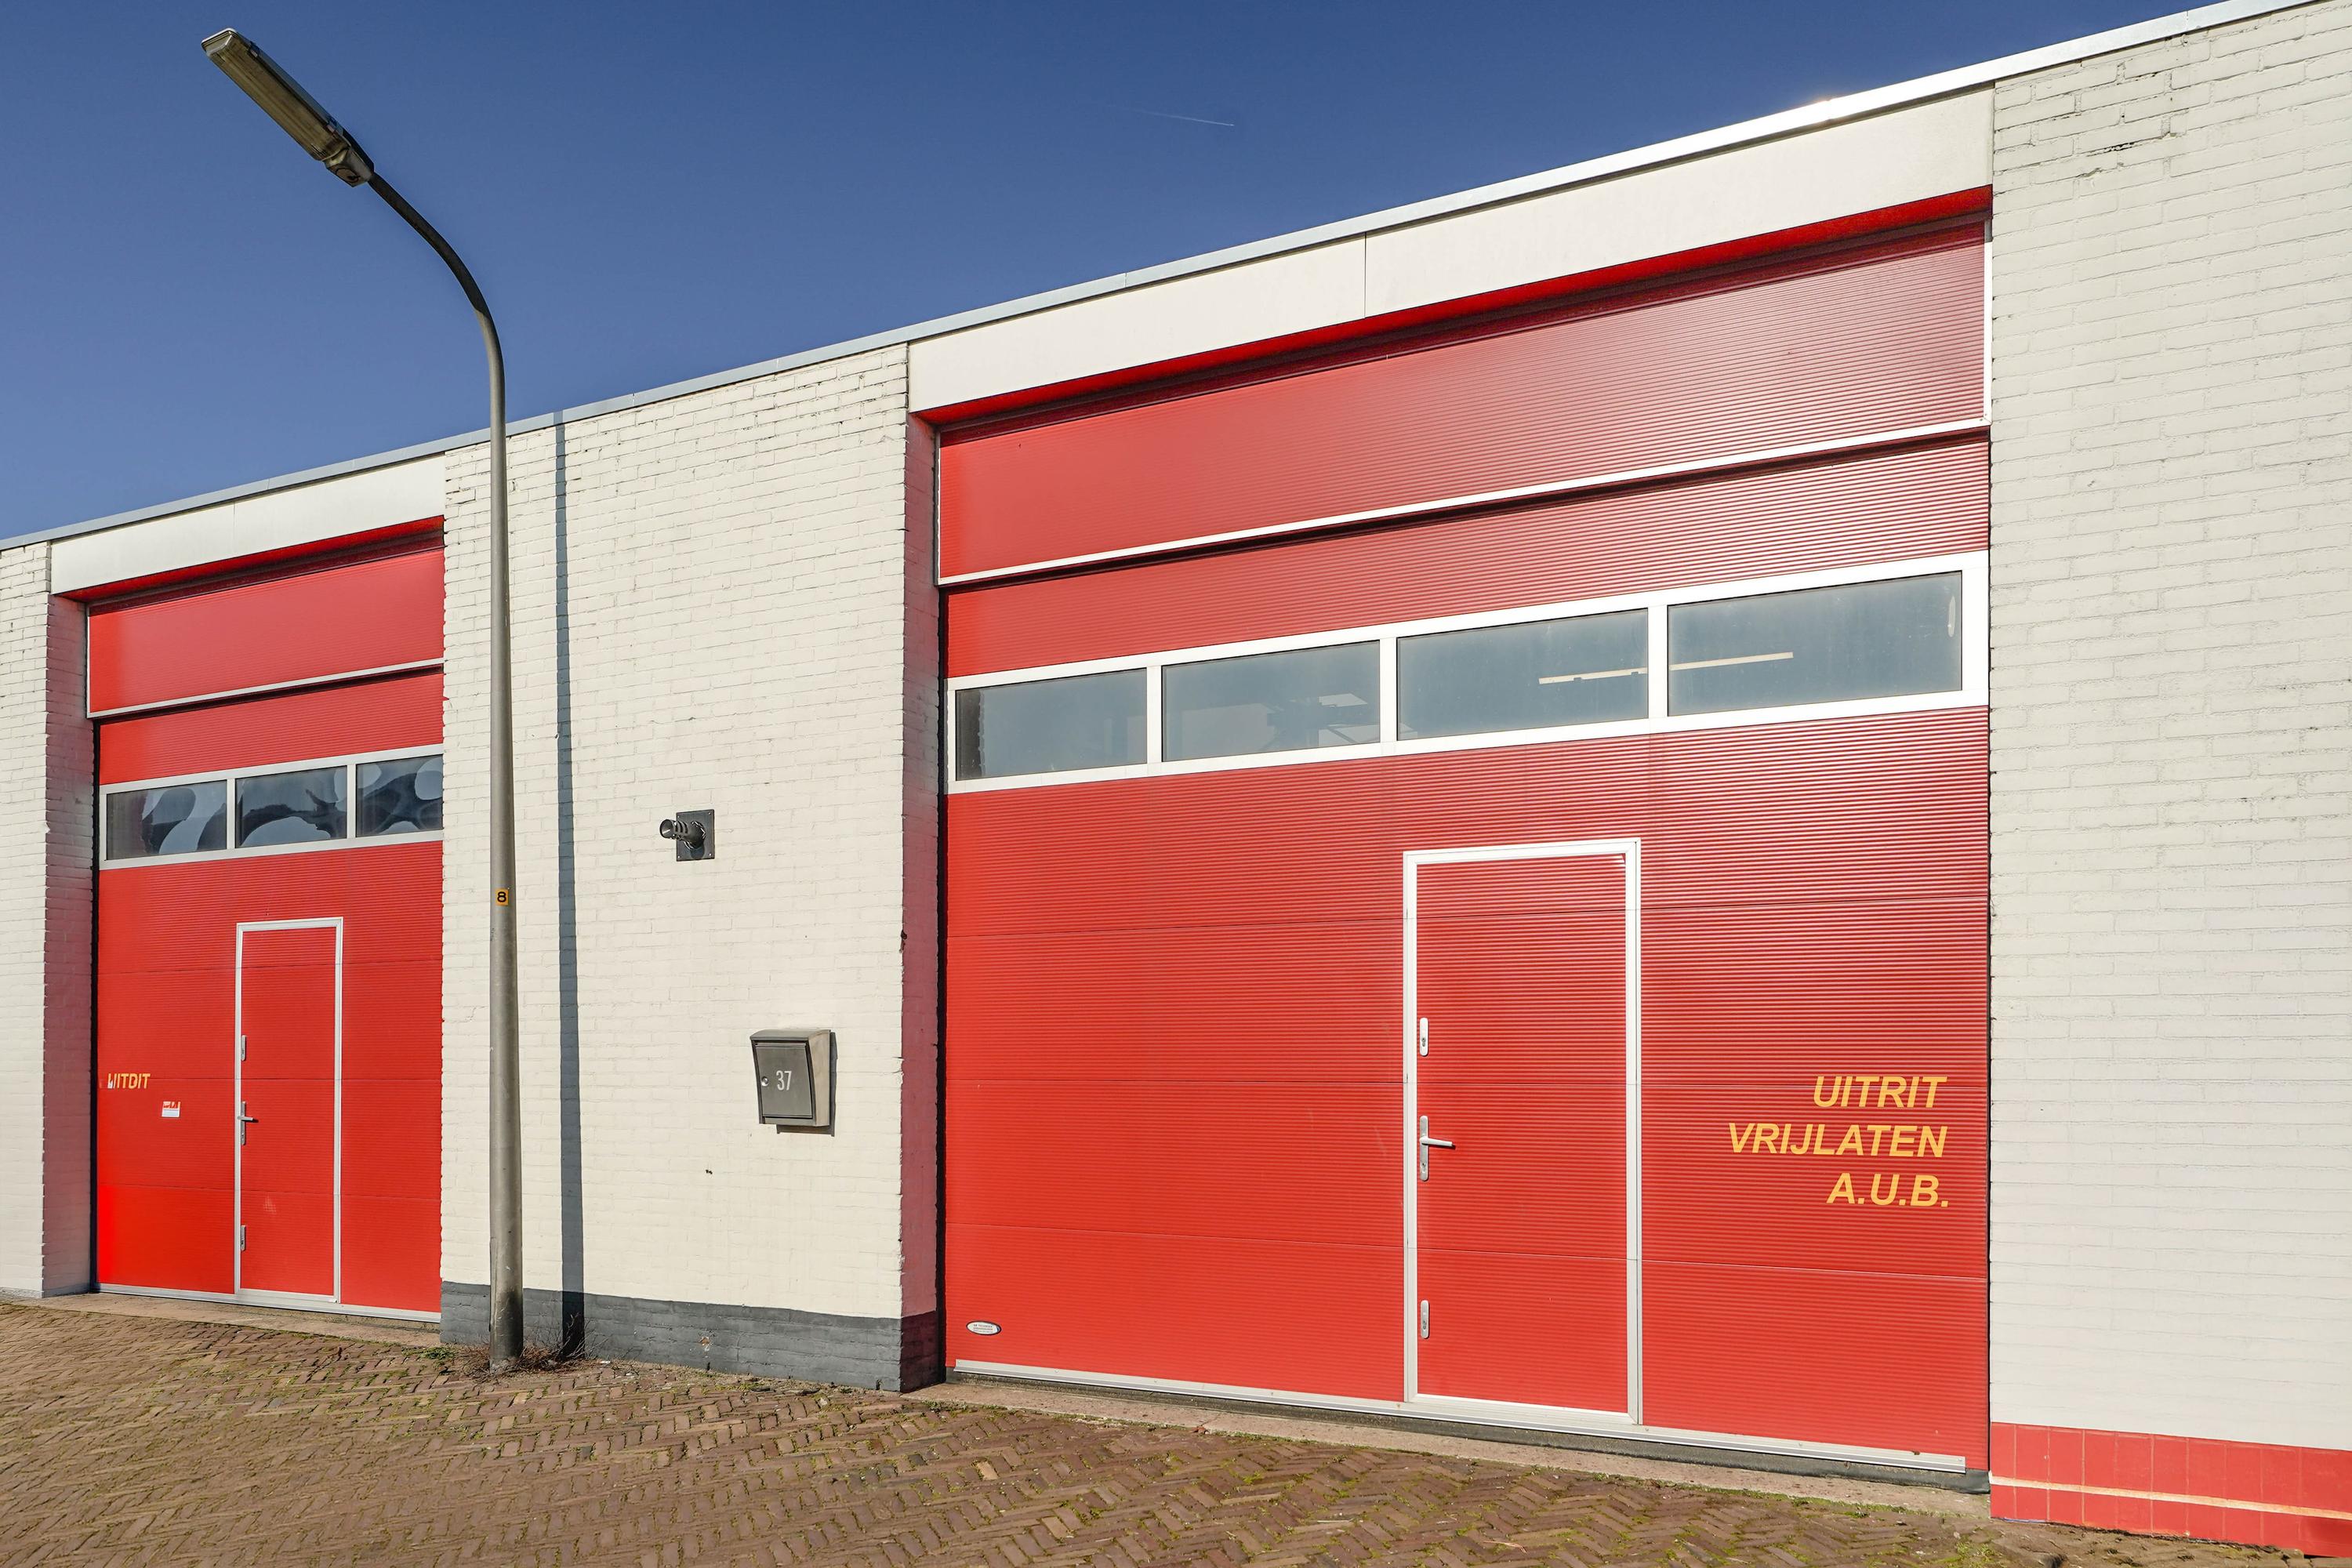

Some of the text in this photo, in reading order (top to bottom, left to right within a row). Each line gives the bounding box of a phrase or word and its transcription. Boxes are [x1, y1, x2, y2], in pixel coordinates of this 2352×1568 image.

[497, 891, 506, 902] 8
[775, 1070, 792, 1091] 37
[1813, 1076, 1948, 1108] UITRIT
[1728, 1122, 1948, 1158] VRIJLATEN
[1826, 1172, 1949, 1207] A.U.B.
